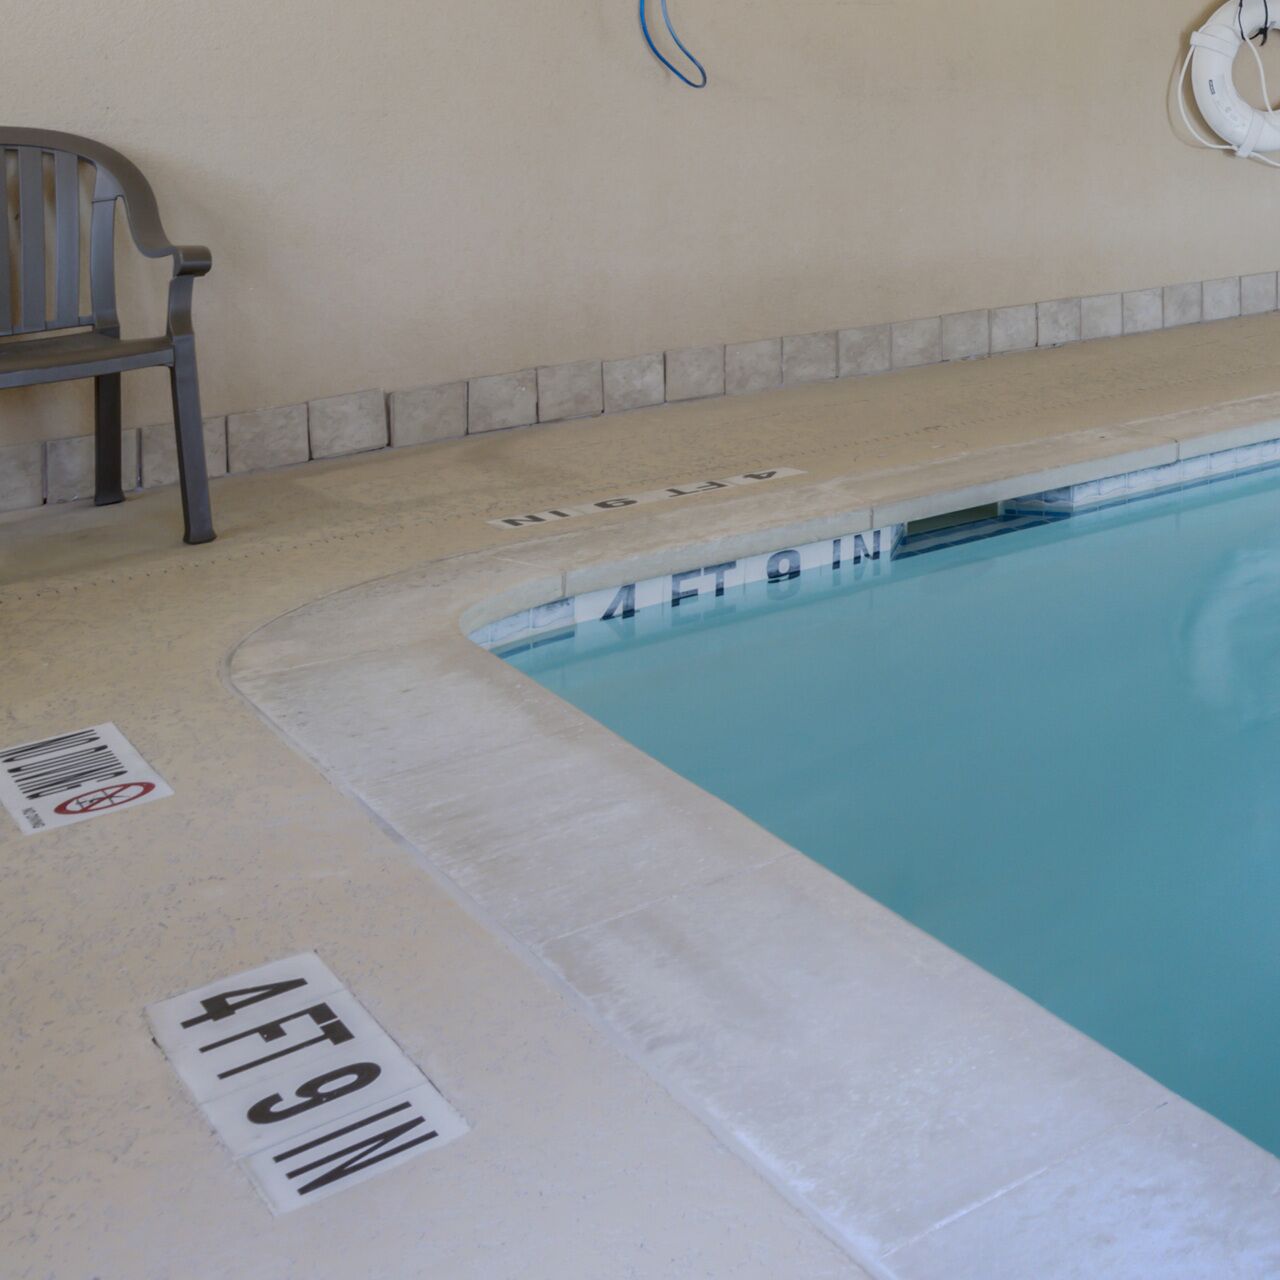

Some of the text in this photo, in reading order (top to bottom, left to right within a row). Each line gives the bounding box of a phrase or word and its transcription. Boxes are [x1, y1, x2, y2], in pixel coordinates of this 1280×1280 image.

[502, 470, 777, 527] 4 FT 9 IN
[672, 560, 737, 607] FT
[832, 530, 881, 570] IN
[0, 729, 101, 763] NO
[7, 744, 129, 800] DIVING
[180, 978, 439, 1196] 4 FT 9 IN
